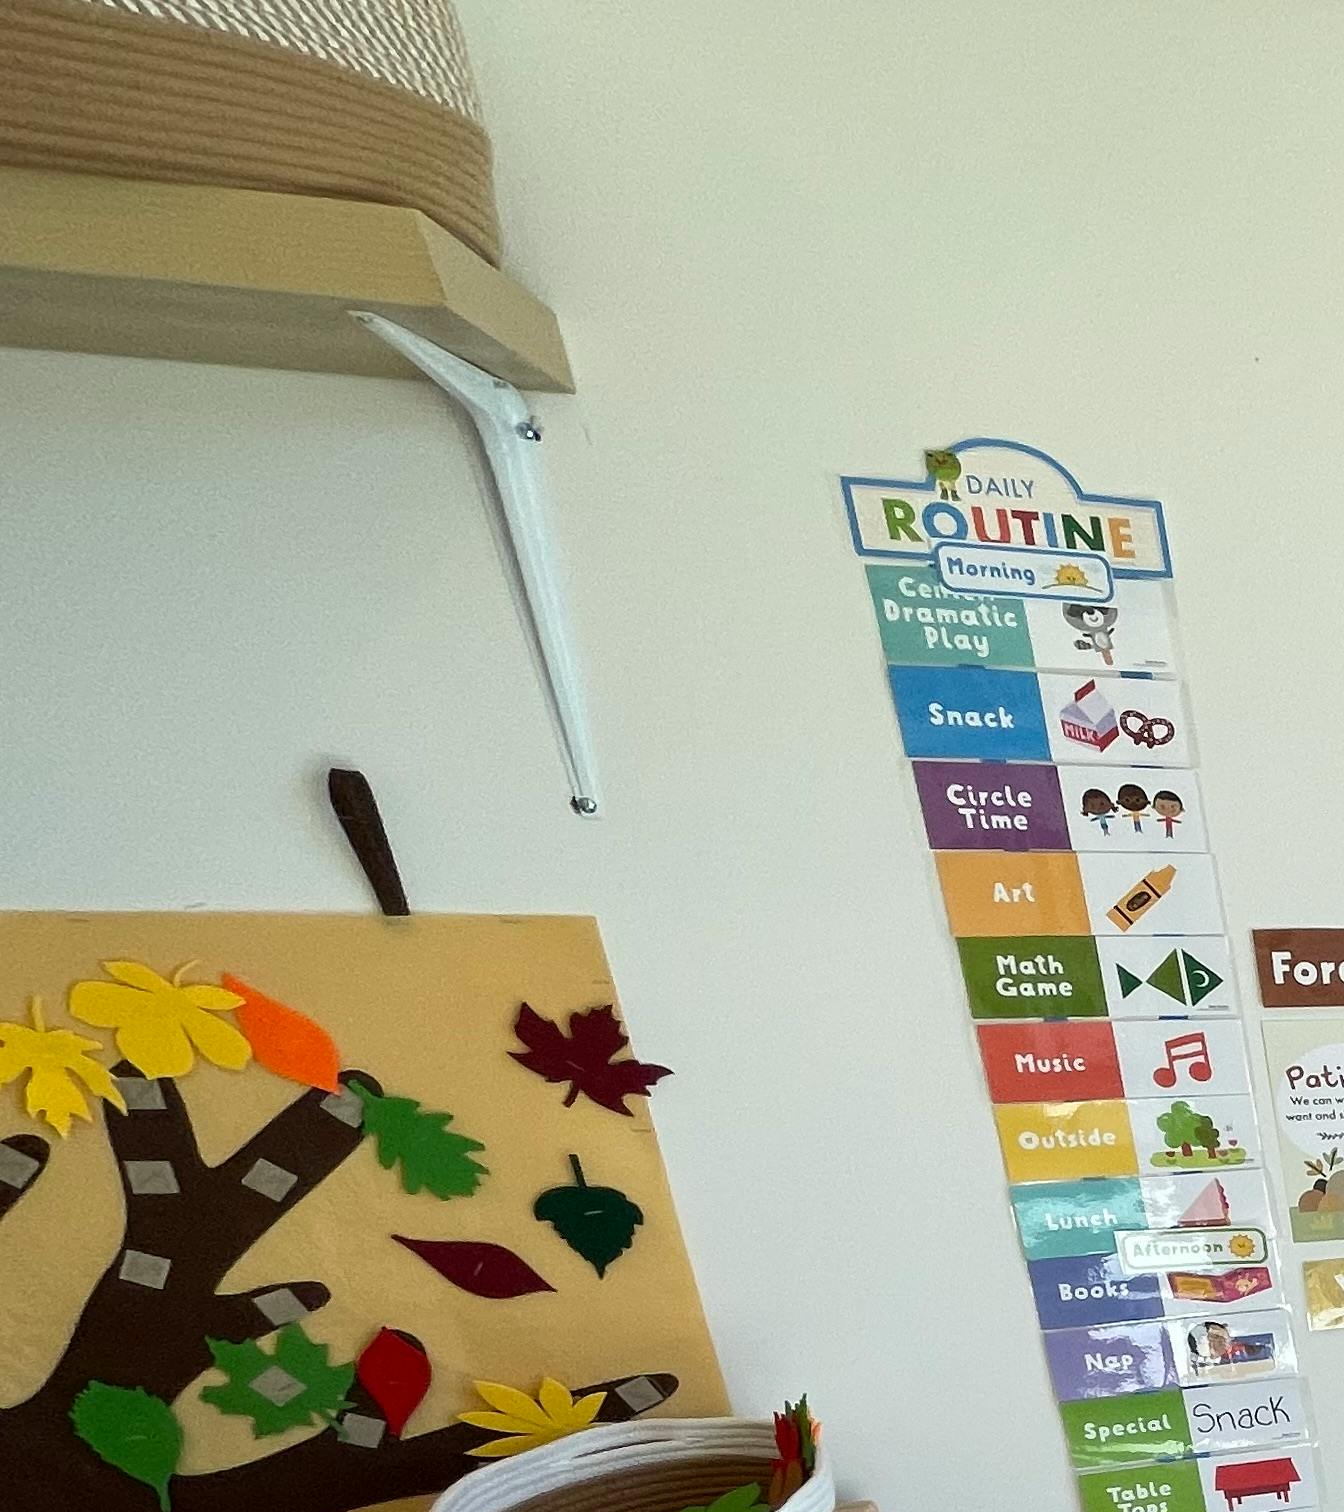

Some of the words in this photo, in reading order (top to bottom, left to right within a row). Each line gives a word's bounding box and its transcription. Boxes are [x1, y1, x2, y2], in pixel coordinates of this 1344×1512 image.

[966, 474, 1033, 499] DAILY
[882, 497, 1136, 558] ROUTINE
[947, 556, 1036, 585] Morning
[883, 599, 1018, 628] Dramatic
[924, 627, 989, 658] Play
[928, 702, 1015, 729] Snack
[1063, 720, 1100, 743] MILK
[946, 784, 1033, 811] Circle
[958, 806, 1029, 831] Time
[993, 881, 1035, 904] Art
[996, 955, 1064, 975] Math
[995, 980, 1073, 998] Game
[1014, 1053, 1086, 1073] Music
[1289, 1095, 1310, 1105] We
[1312, 1095, 1332, 1105] can
[1286, 1112, 1312, 1122] want
[1316, 1109, 1336, 1120] and
[1017, 1130, 1116, 1150] Outside
[1044, 1209, 1118, 1232] Lunch
[1133, 1241, 1223, 1257] Afternoon
[1058, 1281, 1129, 1302] Books
[1084, 1353, 1133, 1372] Nap
[1084, 1415, 1171, 1442] Special
[1107, 1483, 1171, 1502] Table
